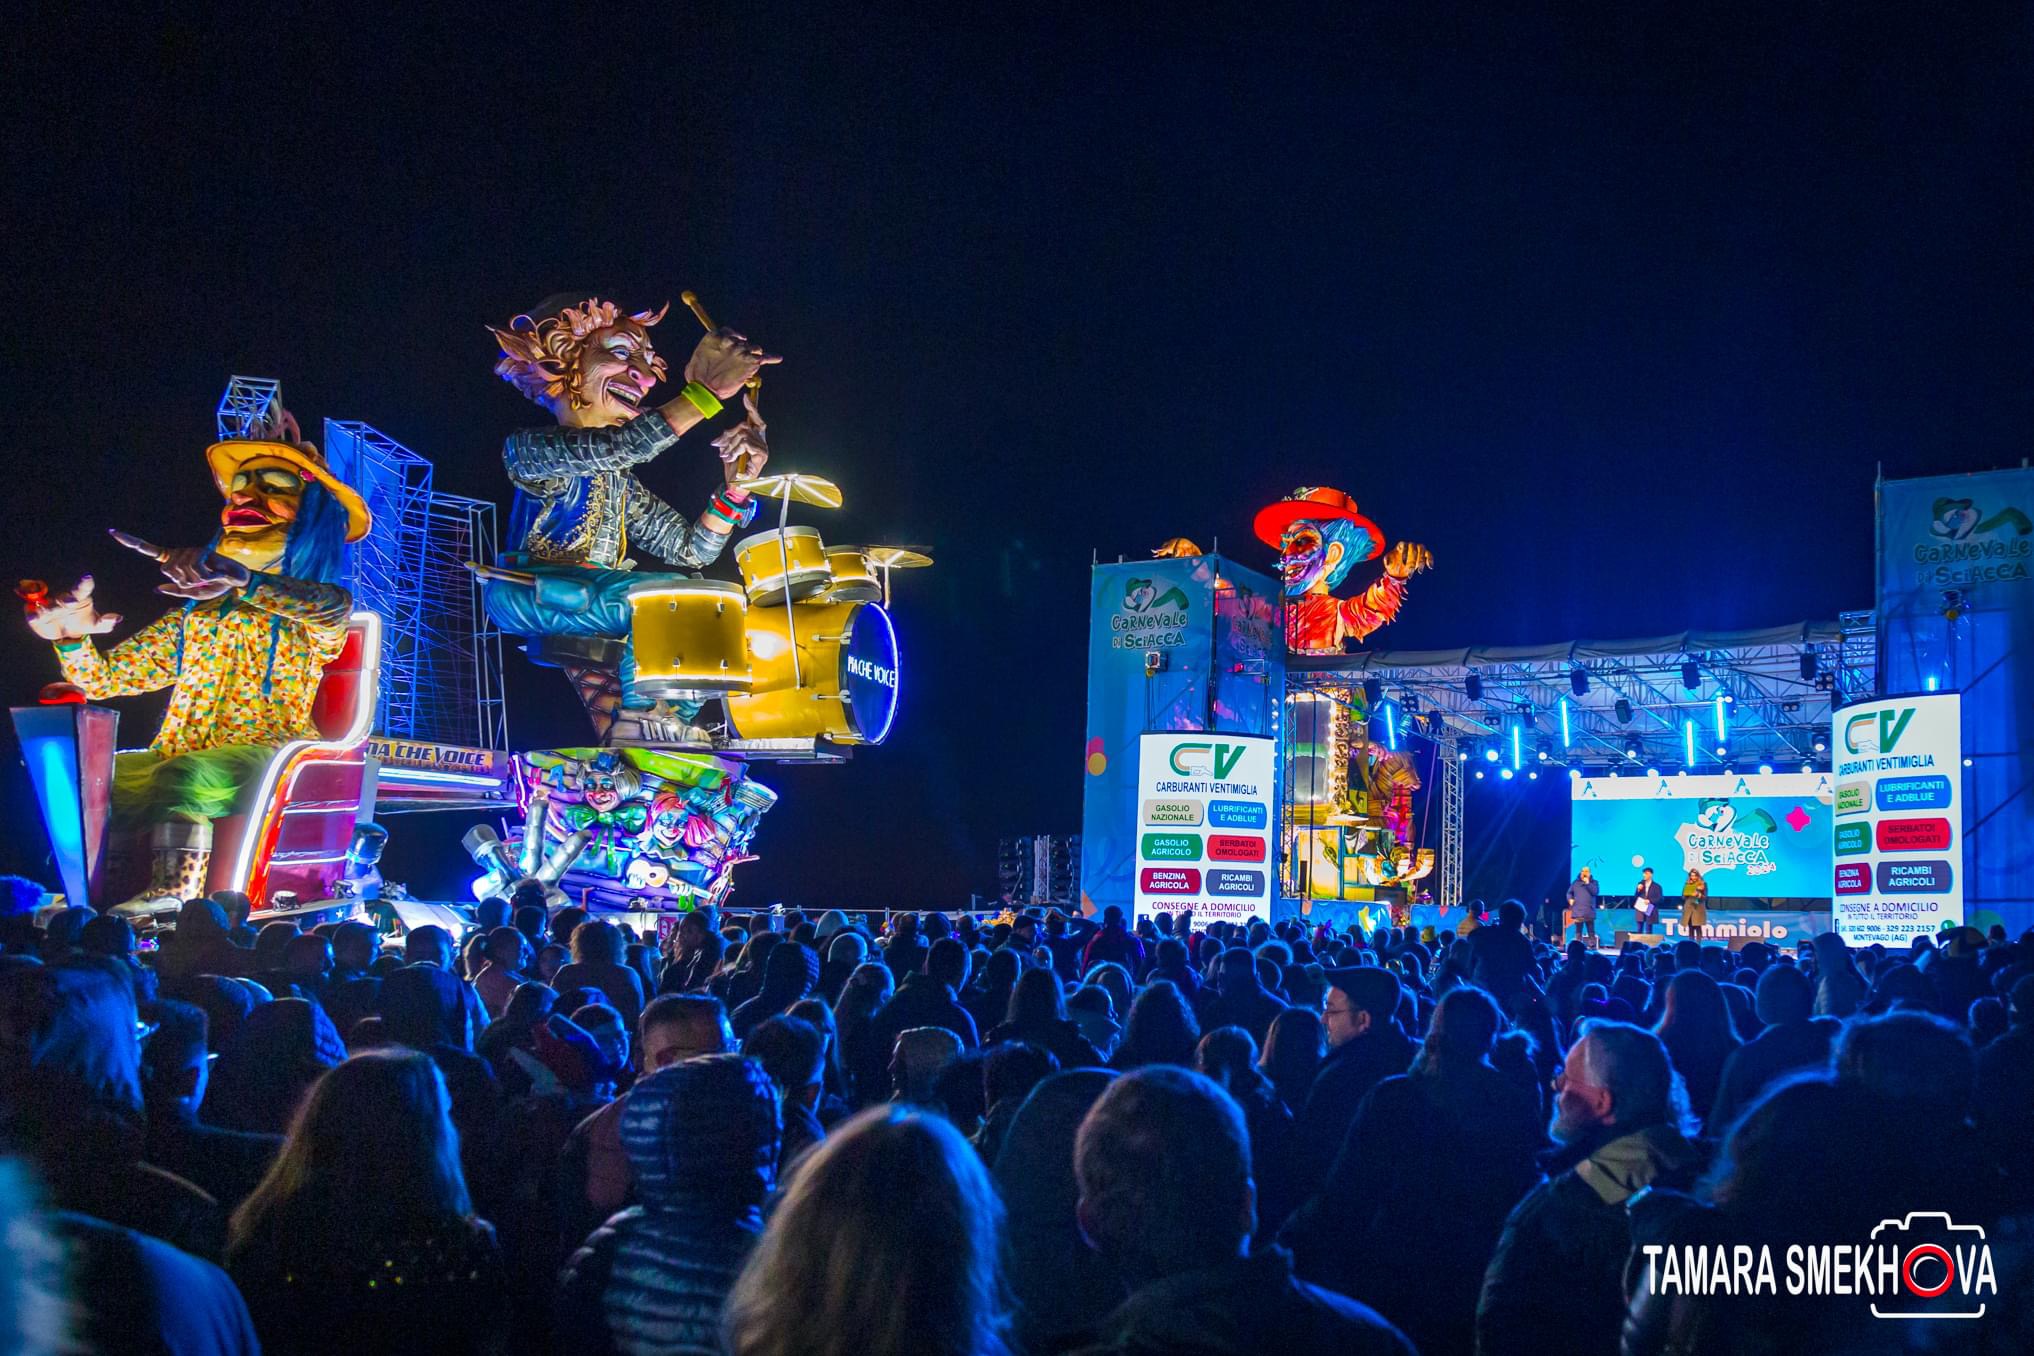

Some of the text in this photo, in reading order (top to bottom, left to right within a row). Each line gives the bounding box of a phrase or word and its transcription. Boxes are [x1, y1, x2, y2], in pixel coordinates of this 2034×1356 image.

[859, 660, 872, 680] CHE
[874, 665, 895, 688] VOICE
[395, 744, 433, 761] CHE
[434, 747, 485, 767] VOICE
[1839, 754, 1935, 776] ARBURANTI VENTIMIGLIA
[1156, 781, 1258, 796] CARBURANTI VENTIMIGLIA
[1880, 781, 1945, 793] LUBRIFICANTI
[1887, 792, 1935, 802] E ADBLUE
[1155, 804, 1190, 812] GASOLIO
[1213, 805, 1263, 815] LUBRIFICANTI
[1151, 814, 1195, 822] NAZIONALE
[1228, 814, 1257, 823] ADBLUE
[1154, 839, 1189, 847] GASOLIO
[1151, 848, 1192, 856] AGRICOLO
[1891, 866, 1932, 875] RICAMBI
[1153, 872, 1186, 880] BENZINA
[1221, 873, 1253, 882] RICAMBI
[1149, 881, 1190, 889] AGRICOLA
[1218, 883, 1255, 891] AGRICOLI
[1888, 878, 1935, 887] AGRICOLI
[1152, 902, 1256, 912] CONSEGNE A DOMICILIO
[1874, 903, 1879, 912] A
[1882, 902, 1938, 912] DOMICILIO
[1892, 934, 1908, 942] (AG)
